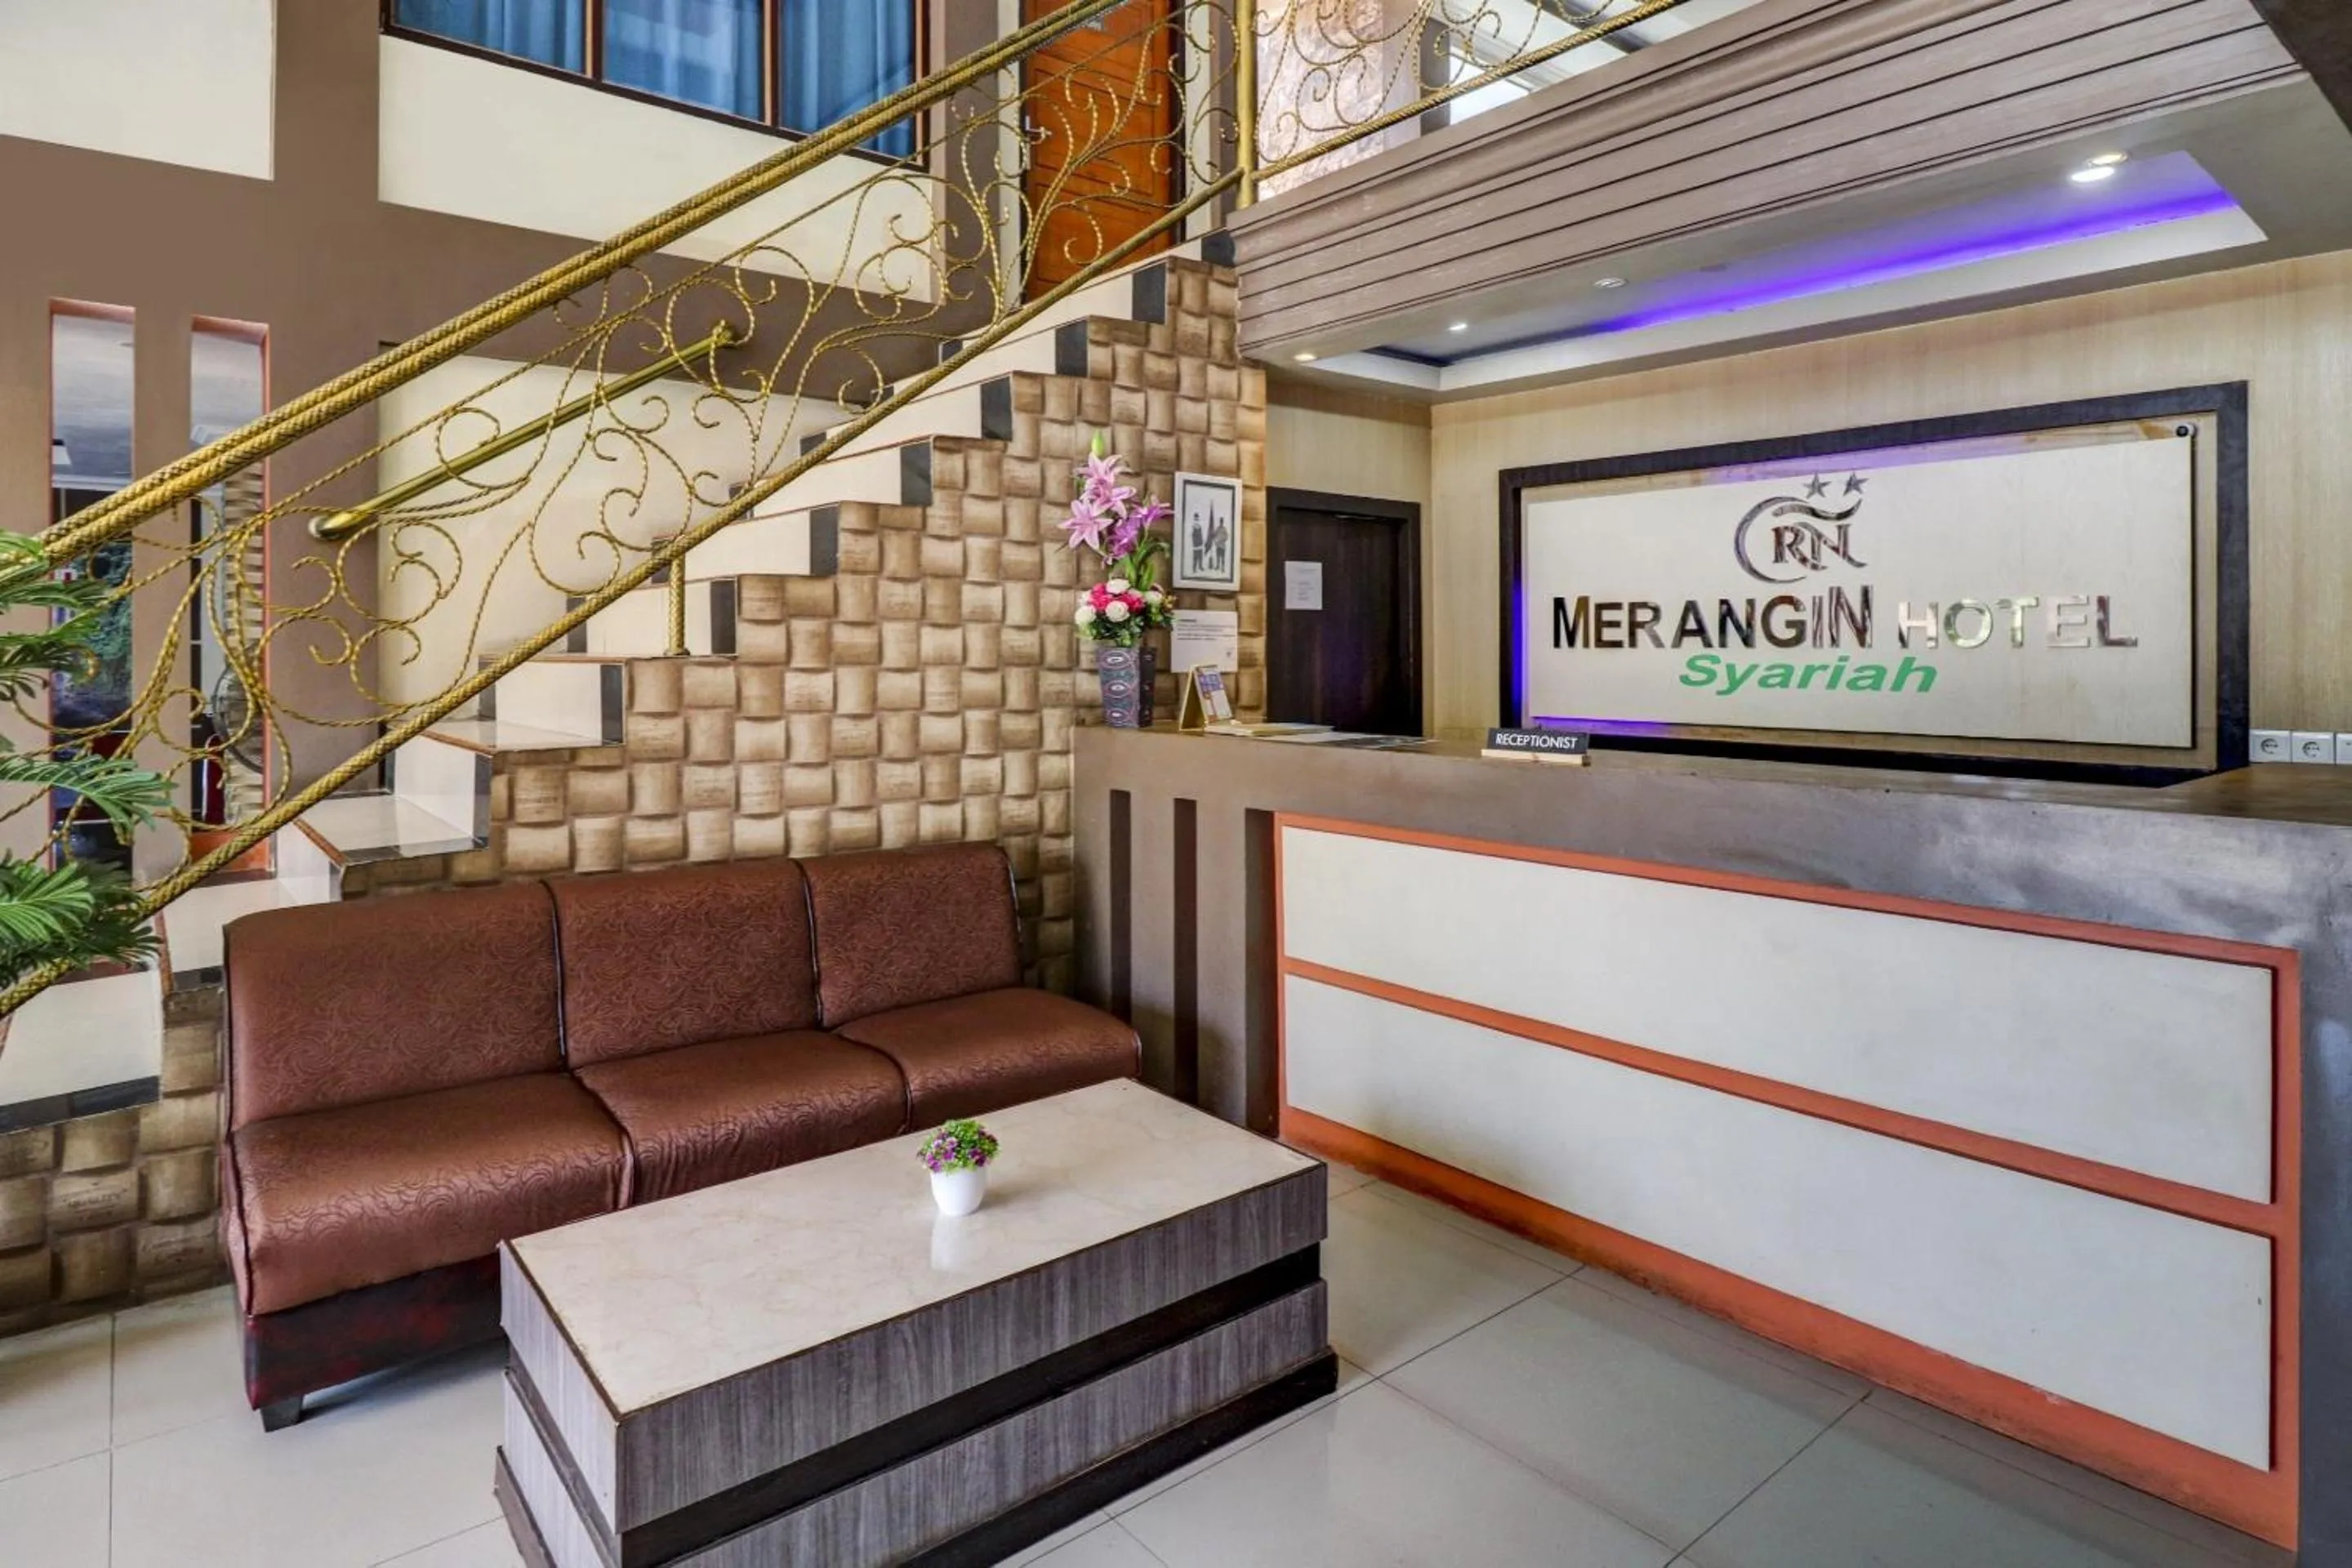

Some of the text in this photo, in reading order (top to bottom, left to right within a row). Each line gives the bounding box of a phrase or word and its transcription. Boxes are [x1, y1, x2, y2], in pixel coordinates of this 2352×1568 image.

[1552, 585, 2138, 650] MERANGIN HOTEL
[1679, 653, 1938, 697] Syariah
[1495, 733, 1578, 749] RECEPTIONIST
